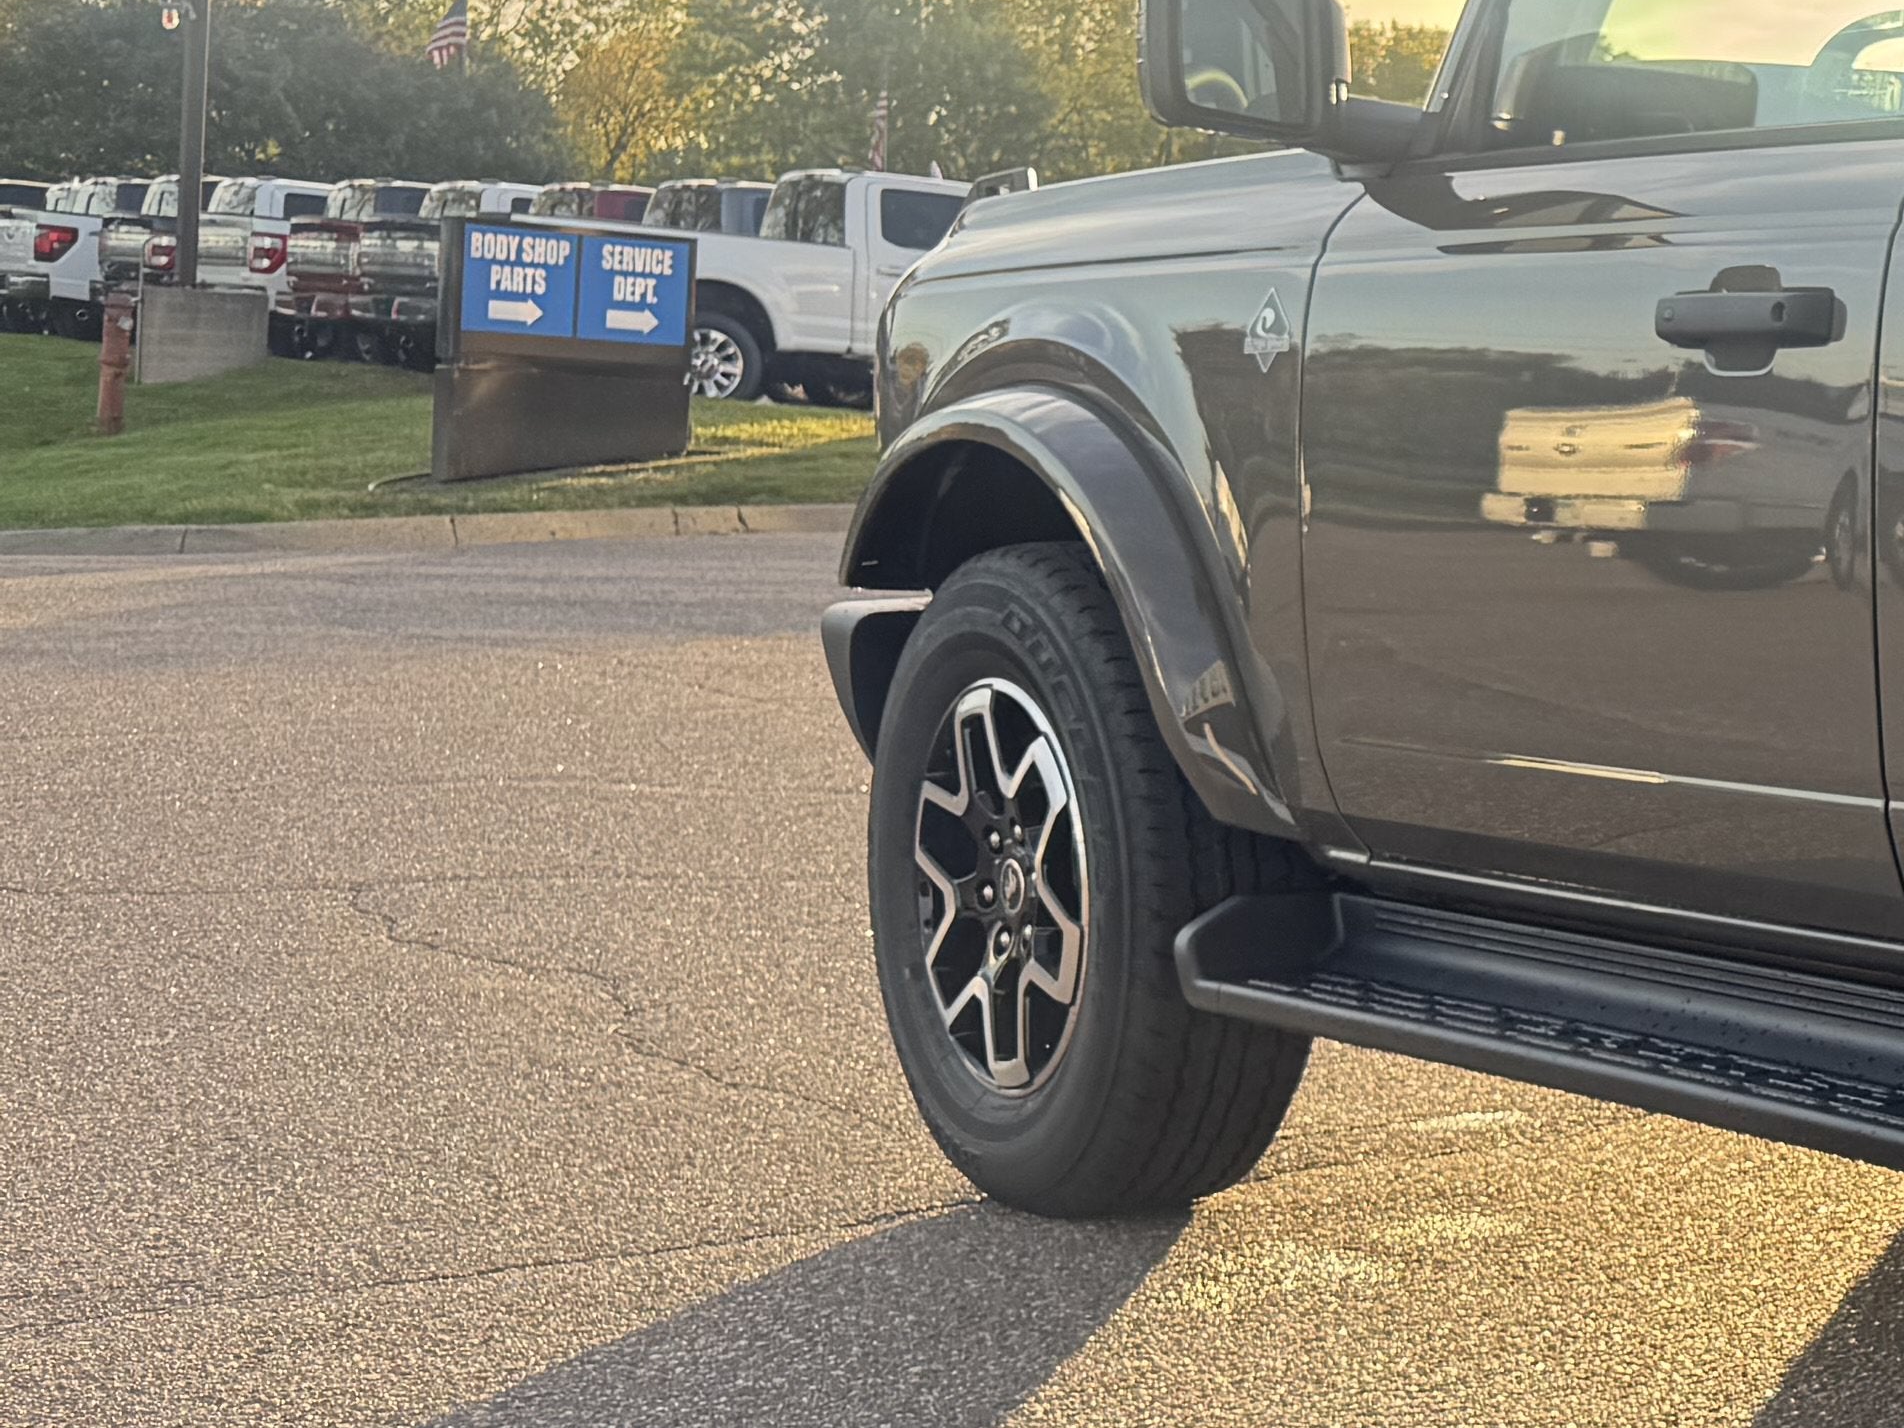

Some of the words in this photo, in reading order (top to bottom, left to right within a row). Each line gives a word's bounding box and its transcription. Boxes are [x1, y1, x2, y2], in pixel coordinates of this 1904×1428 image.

[470, 231, 519, 262] BODY
[522, 236, 571, 266] SHOP
[601, 243, 674, 276] SERVICE
[490, 266, 547, 295] PARTS
[613, 276, 658, 305] DEPT.
